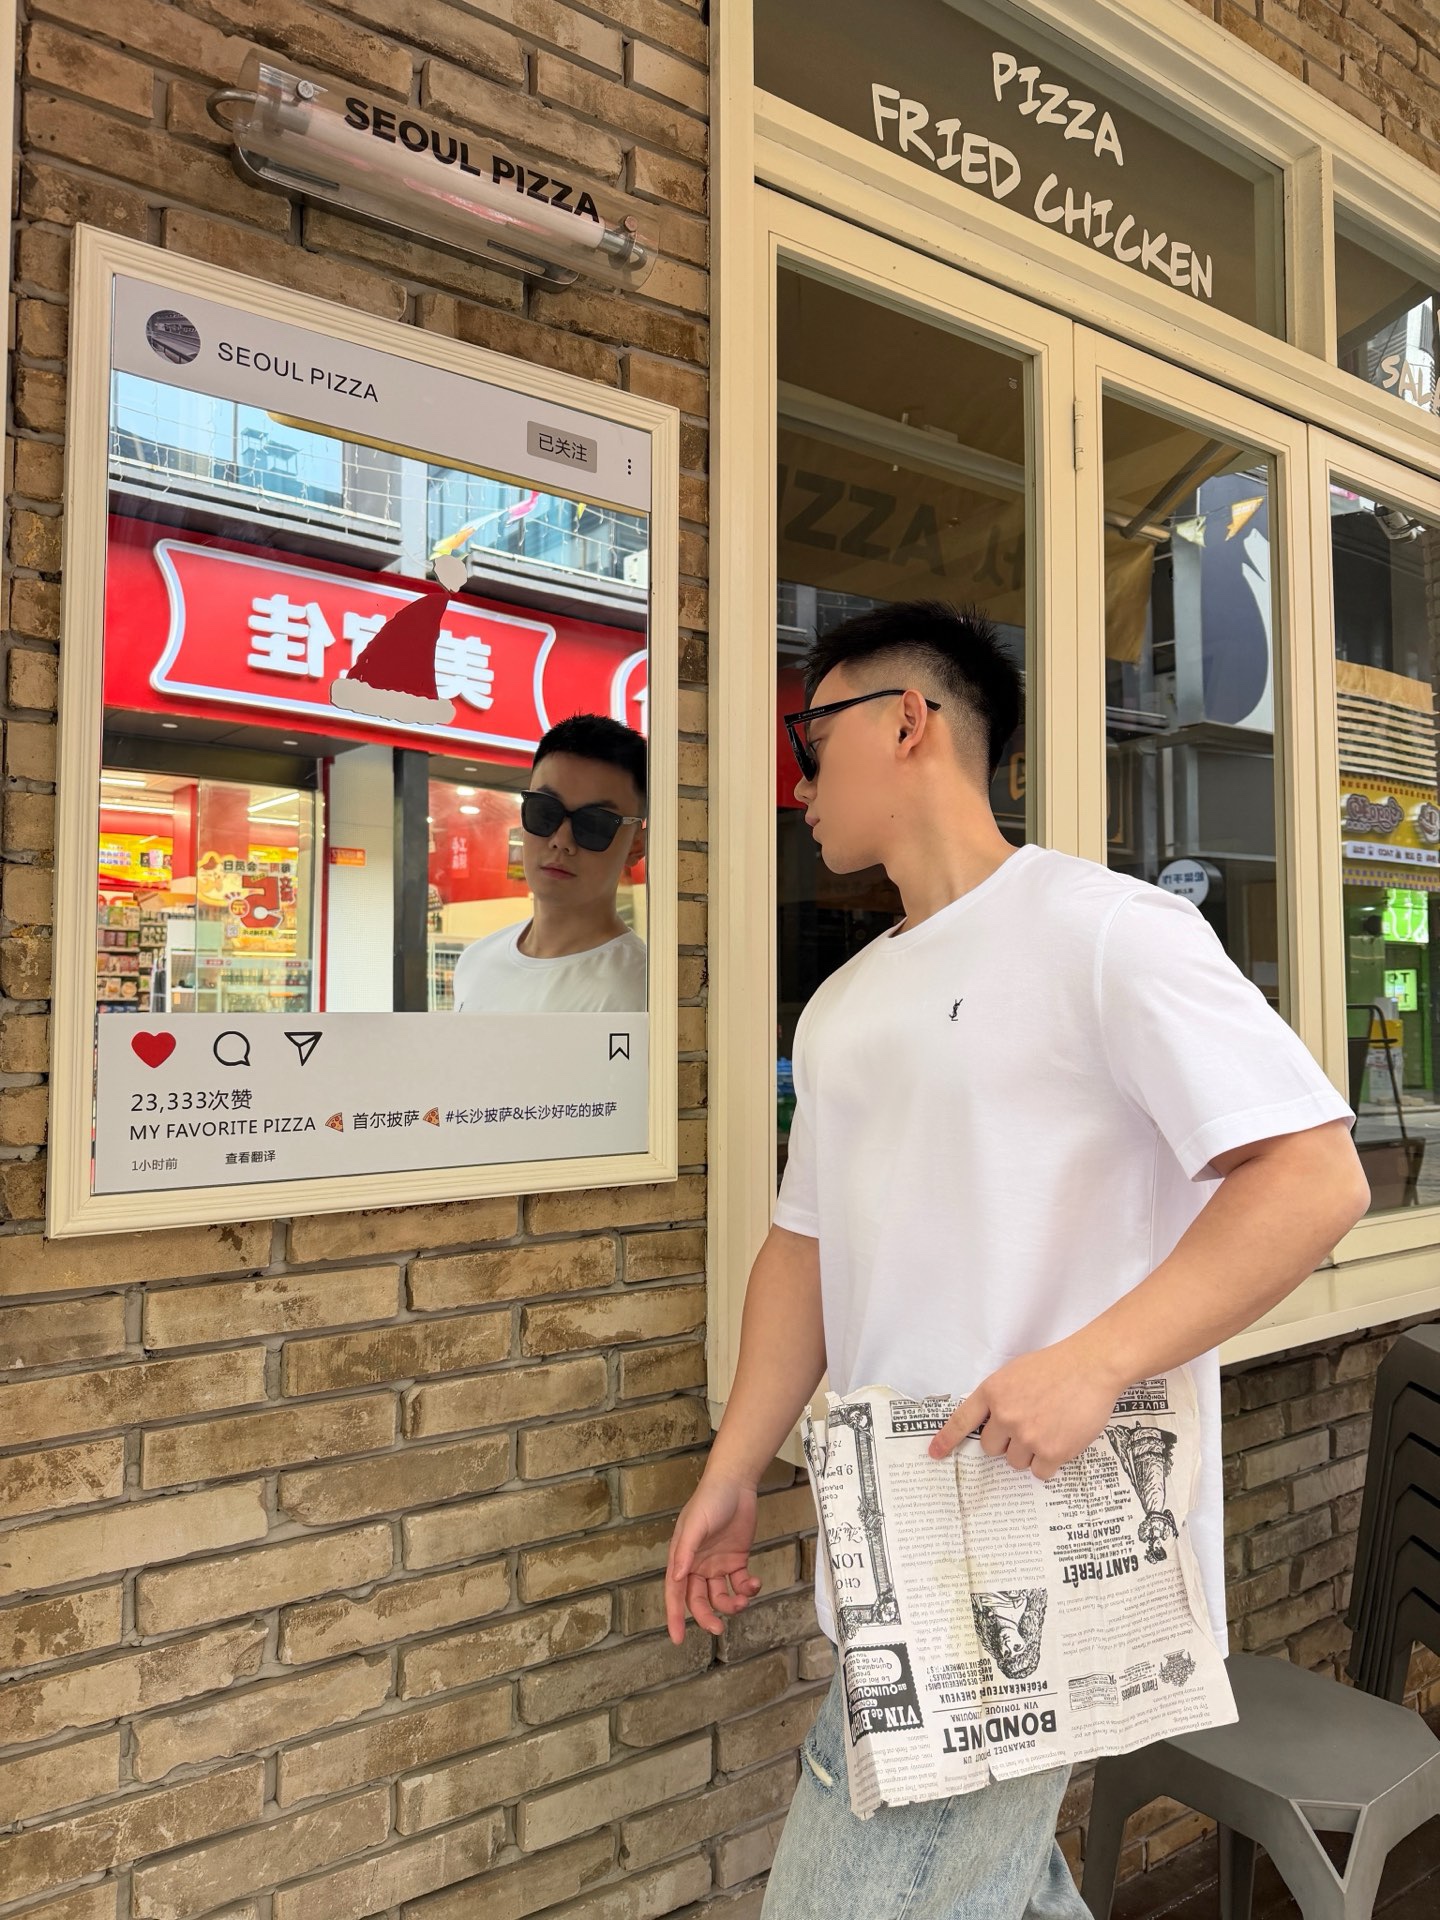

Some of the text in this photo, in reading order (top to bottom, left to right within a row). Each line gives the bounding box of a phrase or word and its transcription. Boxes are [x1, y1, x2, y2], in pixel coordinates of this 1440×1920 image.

[992, 51, 1124, 166] PIZZA
[343, 97, 601, 223] SEOUL PIZZA
[871, 82, 1213, 299] FRIED CHICKEN
[217, 342, 379, 403] SEOUL PIZZA
[537, 432, 588, 463] 已关注
[130, 1088, 253, 1115] 23,333次赞
[129, 1101, 618, 1142] MY FAVORITE PIZZA 首尔披萨 #长沙披萨&长沙好吃的披萨
[131, 1149, 277, 1172] 1小时前 查看翻译
[1131, 1401, 1166, 1410] BUVEZ
[1048, 1524, 1072, 1532] D'OR
[1066, 1524, 1121, 1541] GRAND PRIX
[1105, 1555, 1139, 1578] GANT
[941, 1679, 967, 1688] CHEVEUX
[938, 1690, 977, 1704] CHEVEUX
[1023, 1701, 1039, 1711] VIN
[870, 1708, 884, 1720] de
[884, 1704, 920, 1729] VIN
[984, 1702, 1020, 1716] TONIQUE
[993, 1739, 1036, 1756] DEMANDEZ
[962, 1756, 972, 1765] UN
